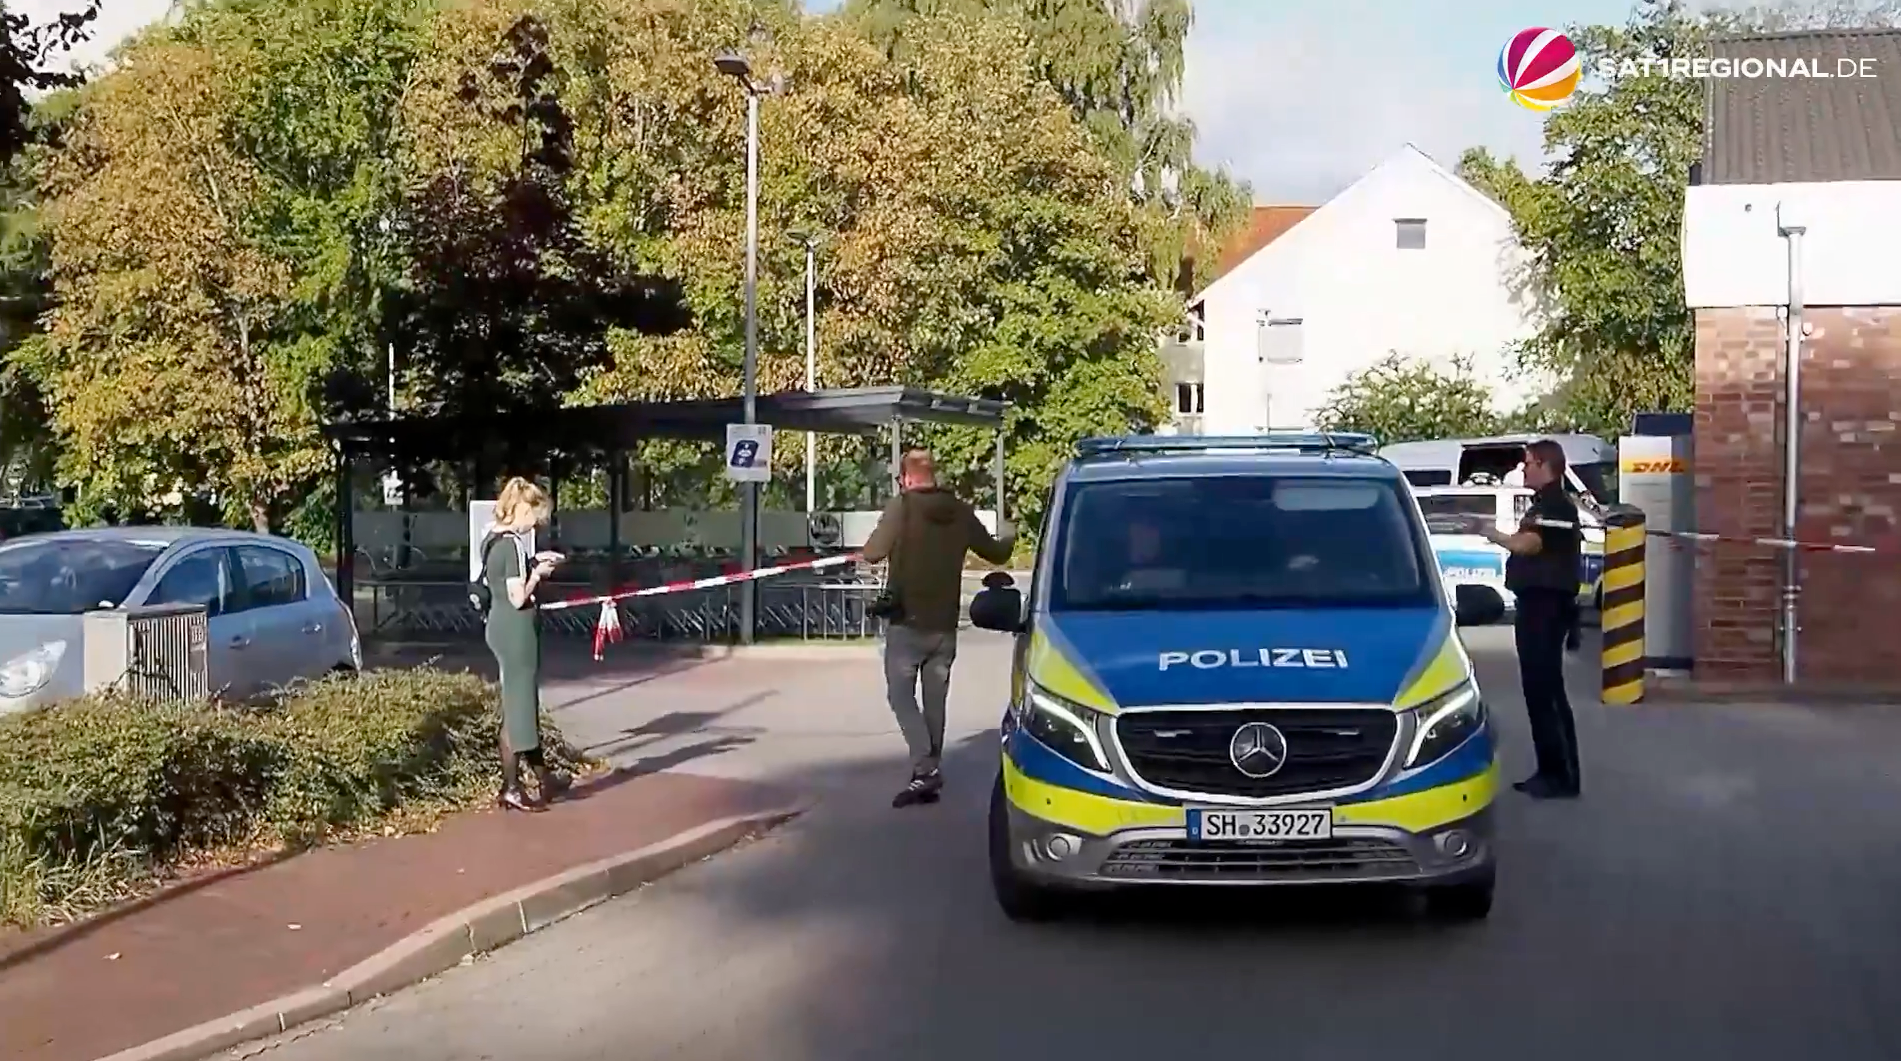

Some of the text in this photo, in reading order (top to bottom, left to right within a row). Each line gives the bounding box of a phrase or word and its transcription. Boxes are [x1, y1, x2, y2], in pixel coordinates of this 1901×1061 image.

[1632, 461, 1684, 472] DHL
[1158, 648, 1349, 671] POLIZEI
[1252, 814, 1325, 835] 33927
